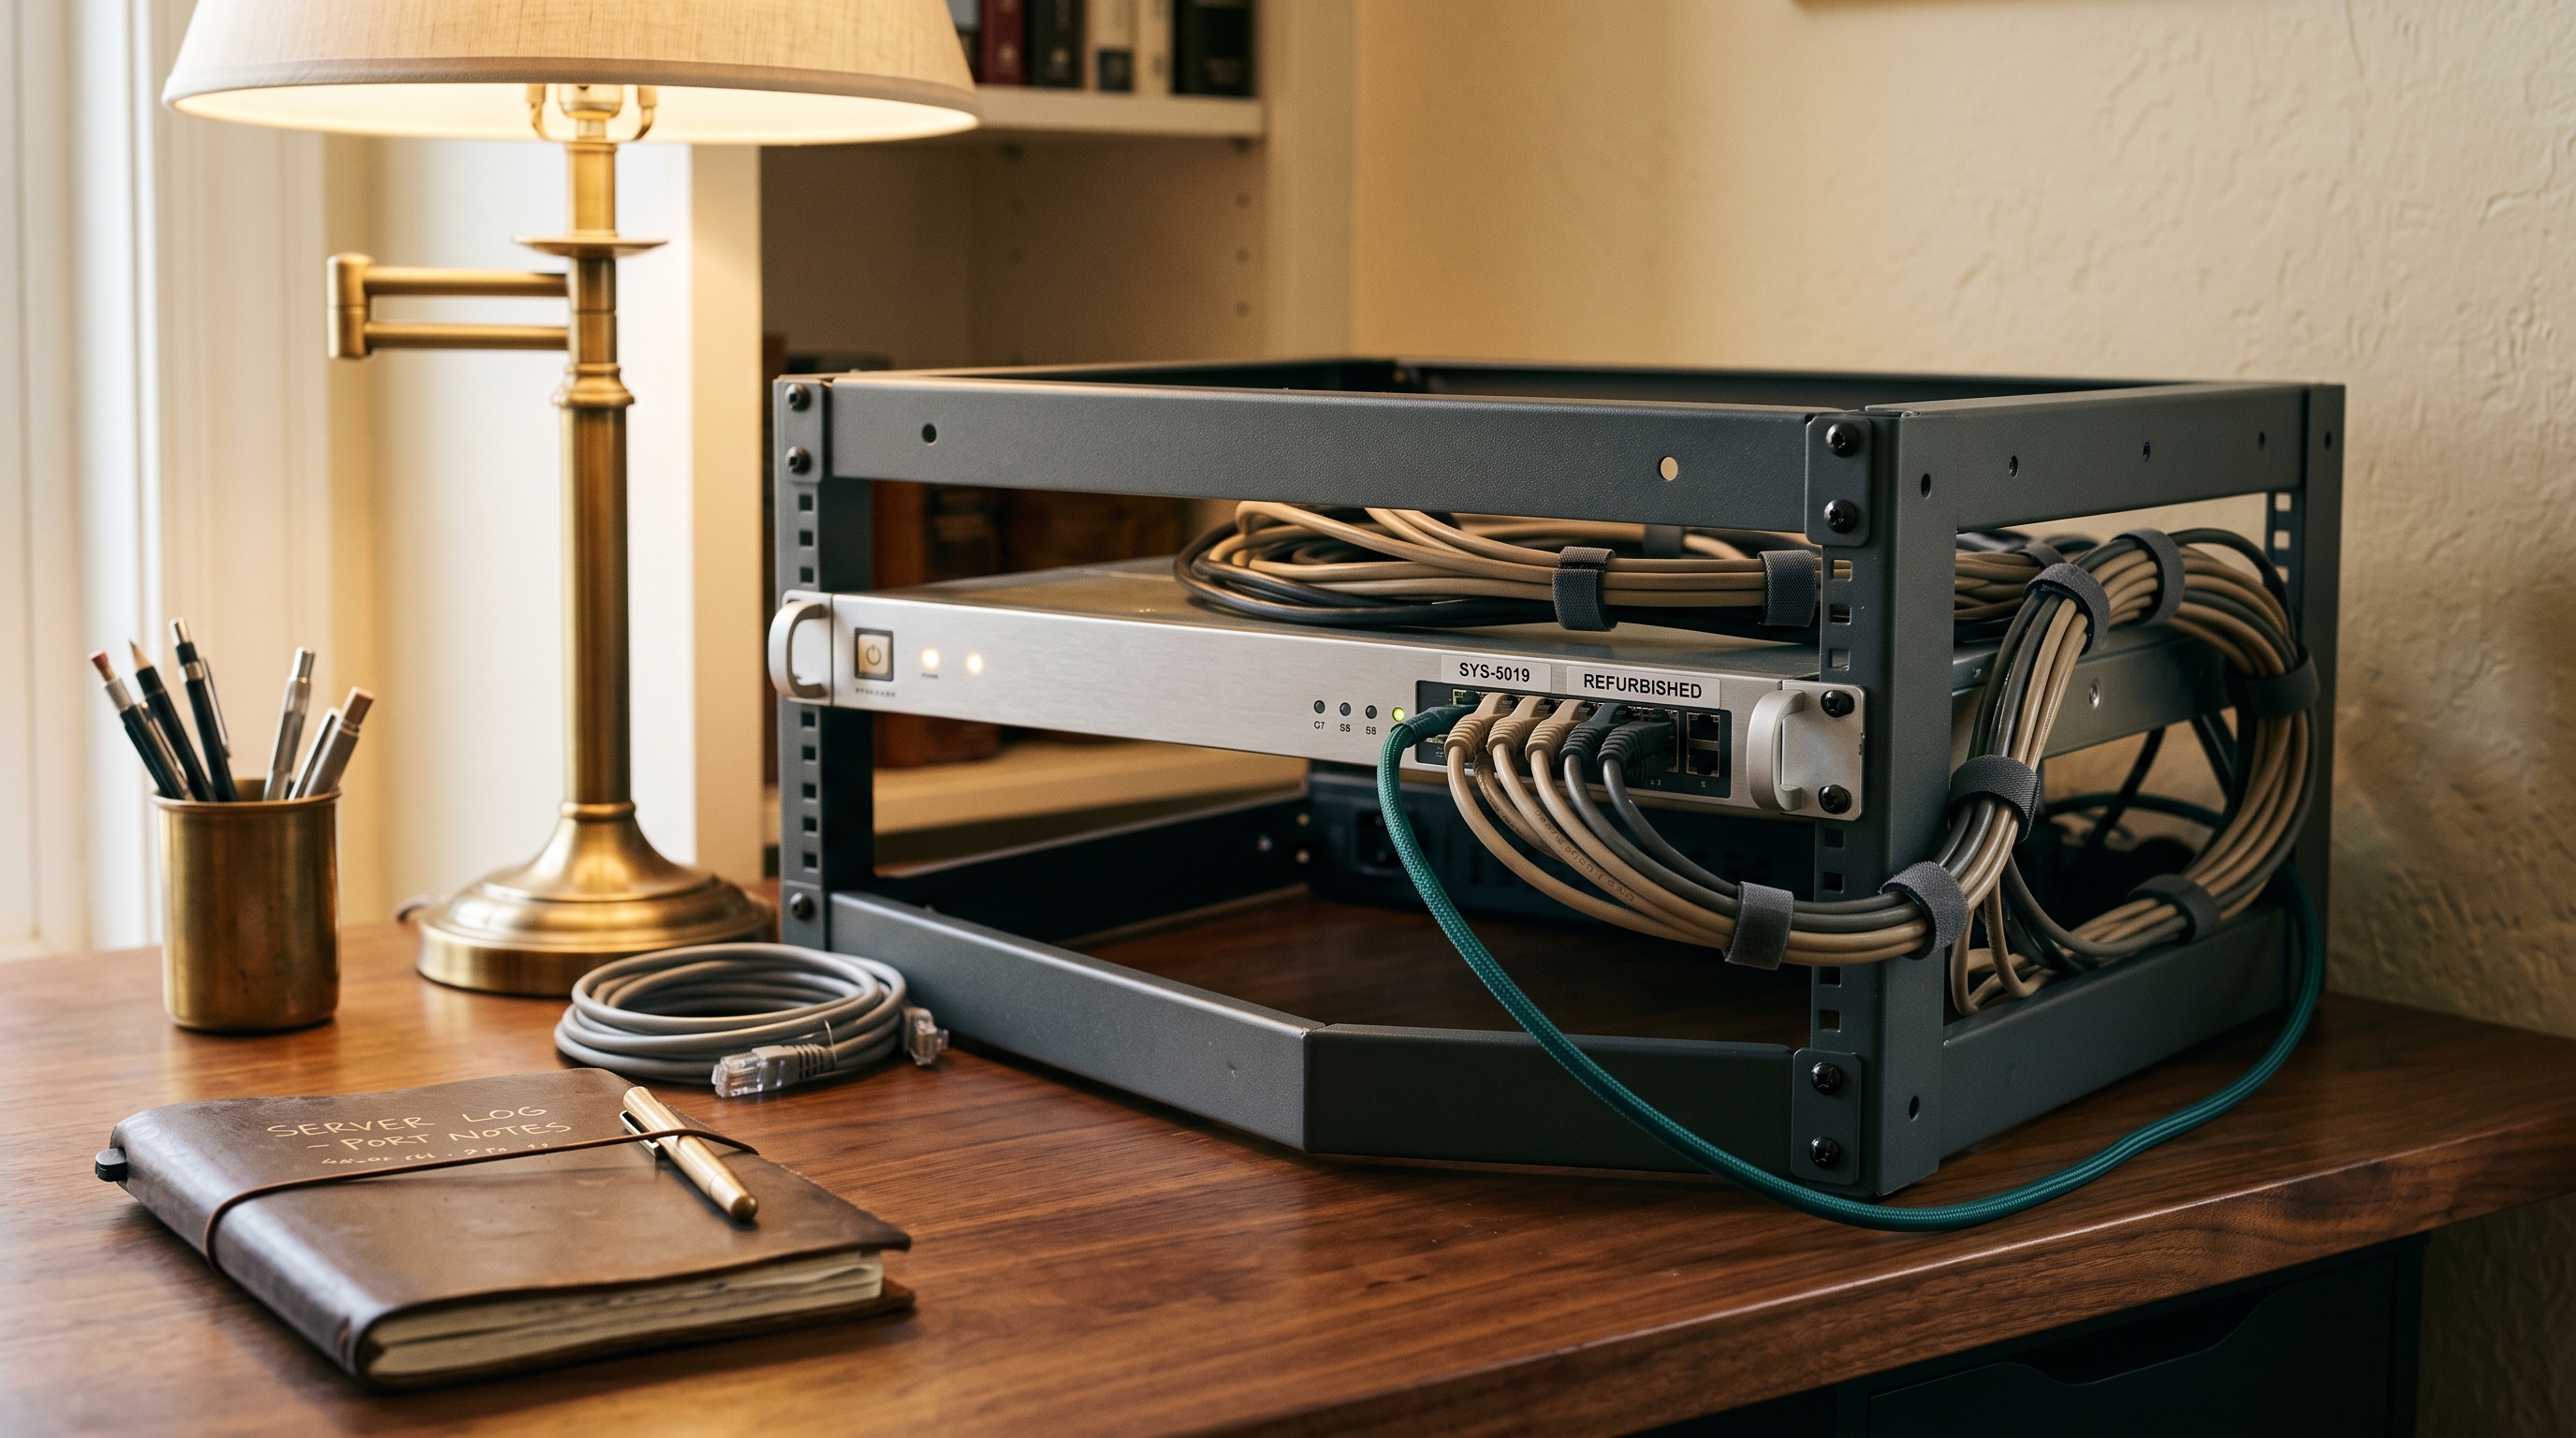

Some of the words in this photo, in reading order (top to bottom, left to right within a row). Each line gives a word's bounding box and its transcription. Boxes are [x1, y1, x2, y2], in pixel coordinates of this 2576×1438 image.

[1459, 662, 1530, 682] SYS-5019
[1584, 673, 1702, 698] REFURBISHED
[1313, 720, 1325, 729] G7
[267, 1117, 436, 1137] SERVER
[462, 1106, 547, 1123] LOG
[341, 1134, 429, 1151] PORT
[448, 1122, 572, 1141] NOTES
